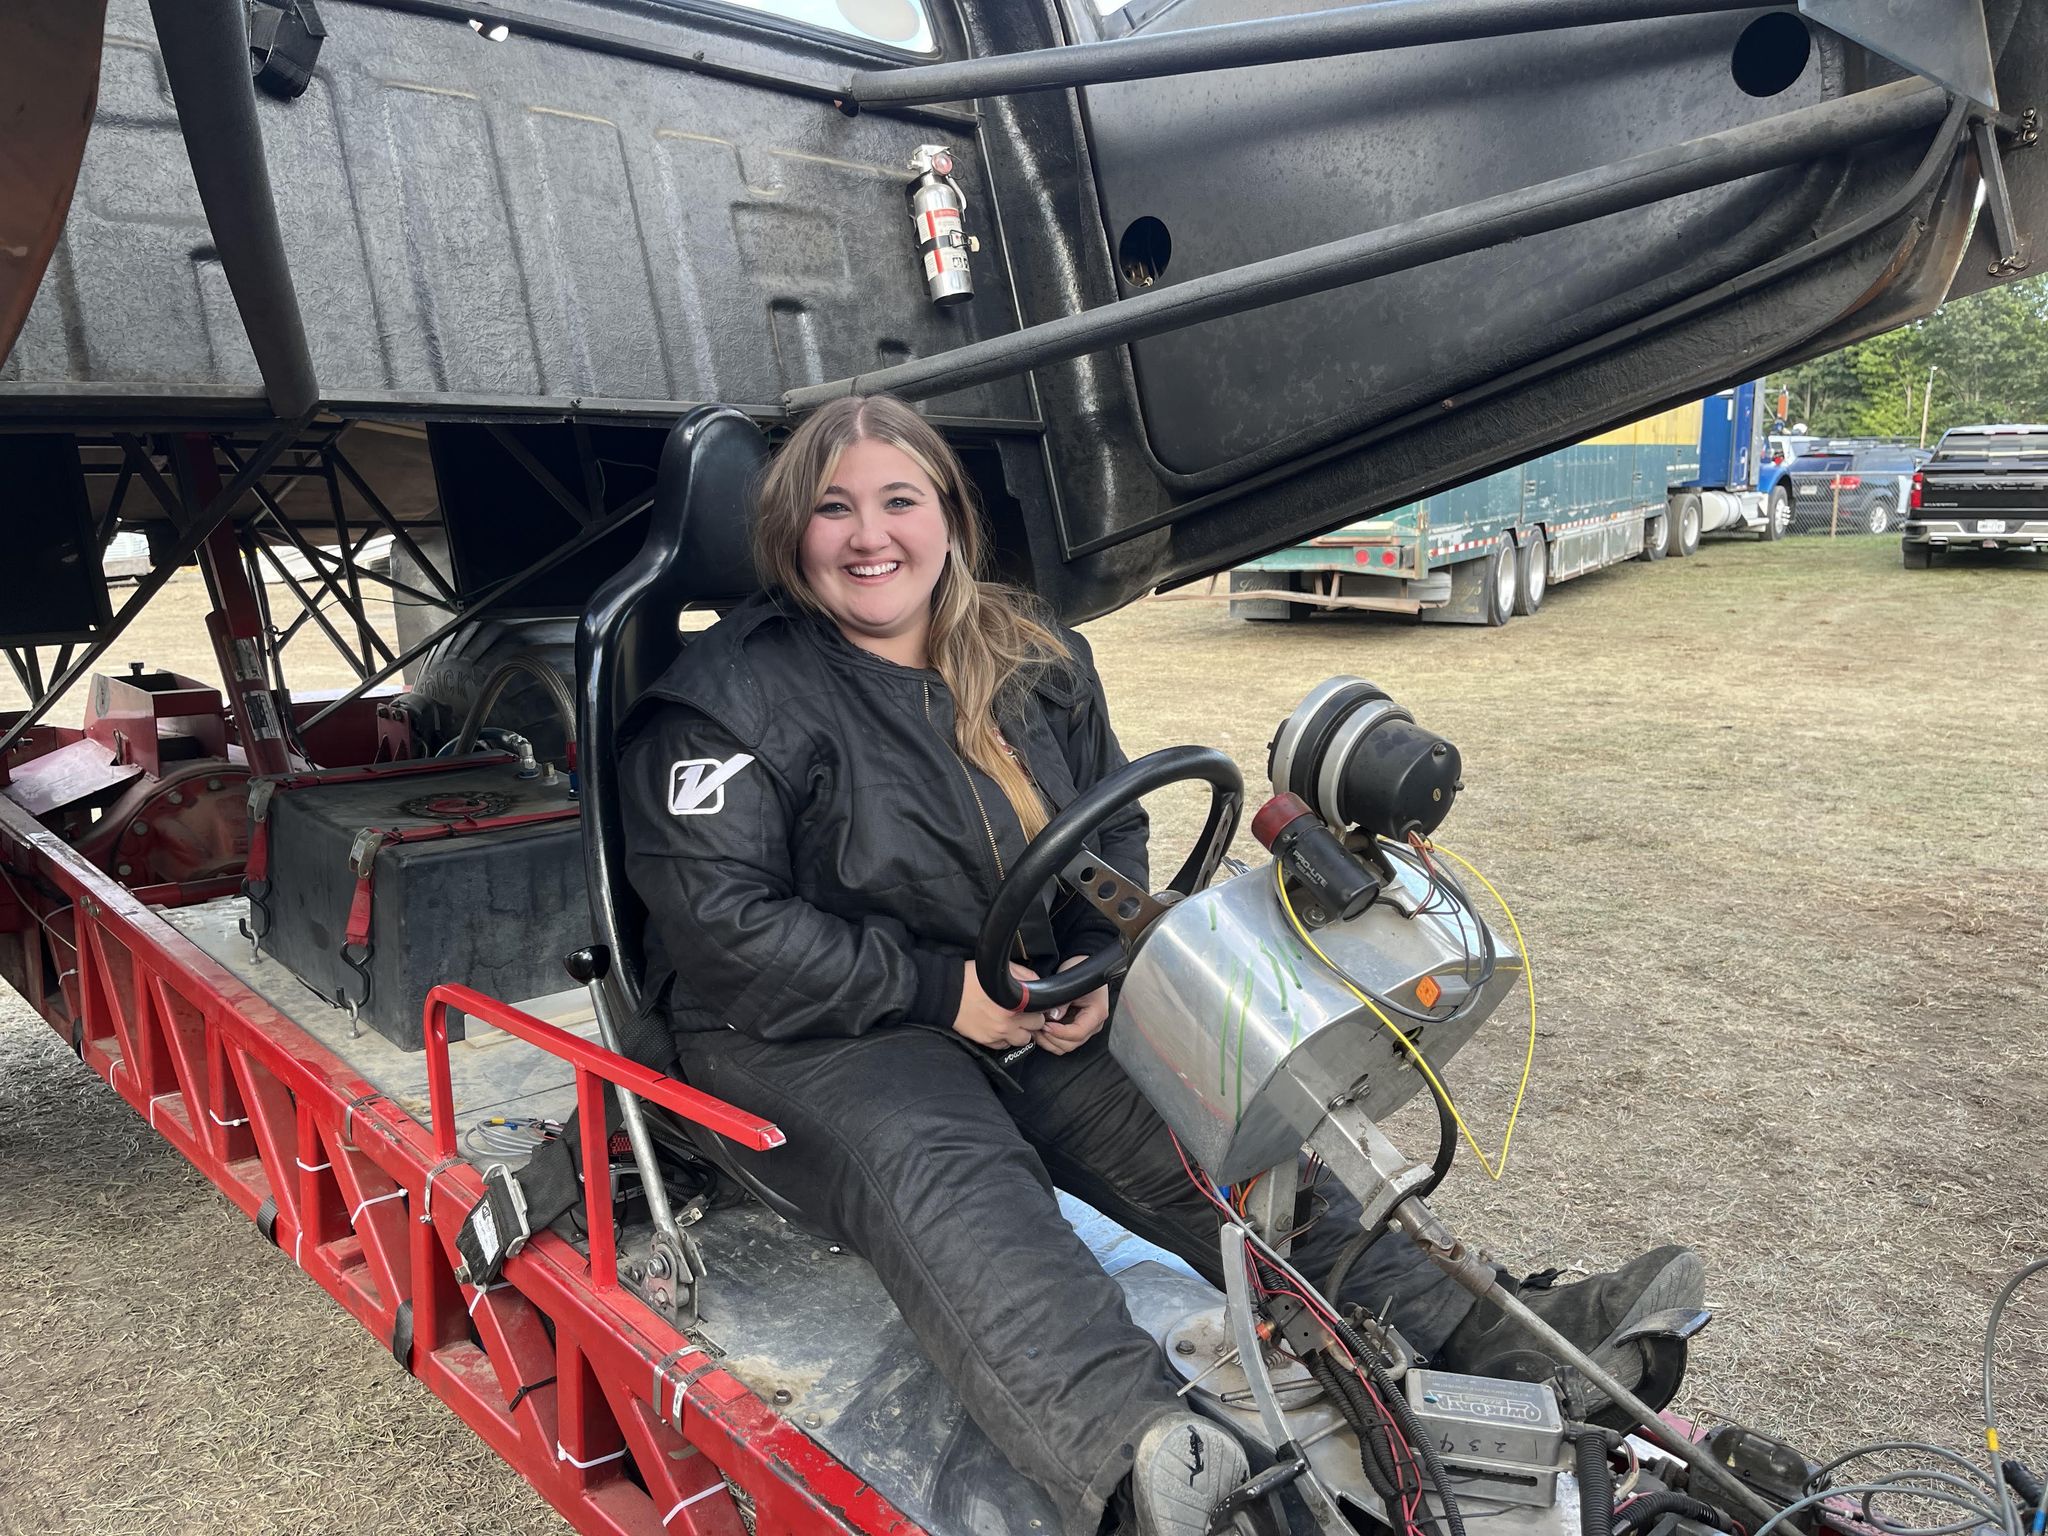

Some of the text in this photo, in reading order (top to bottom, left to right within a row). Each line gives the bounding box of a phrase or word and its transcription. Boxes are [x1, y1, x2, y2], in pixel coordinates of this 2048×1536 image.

[1293, 850, 1328, 887] PRO-LITE
[1440, 1432, 1455, 1453] 4
[1469, 1439, 1482, 1452] 3
[1495, 1442, 1507, 1453] 2
